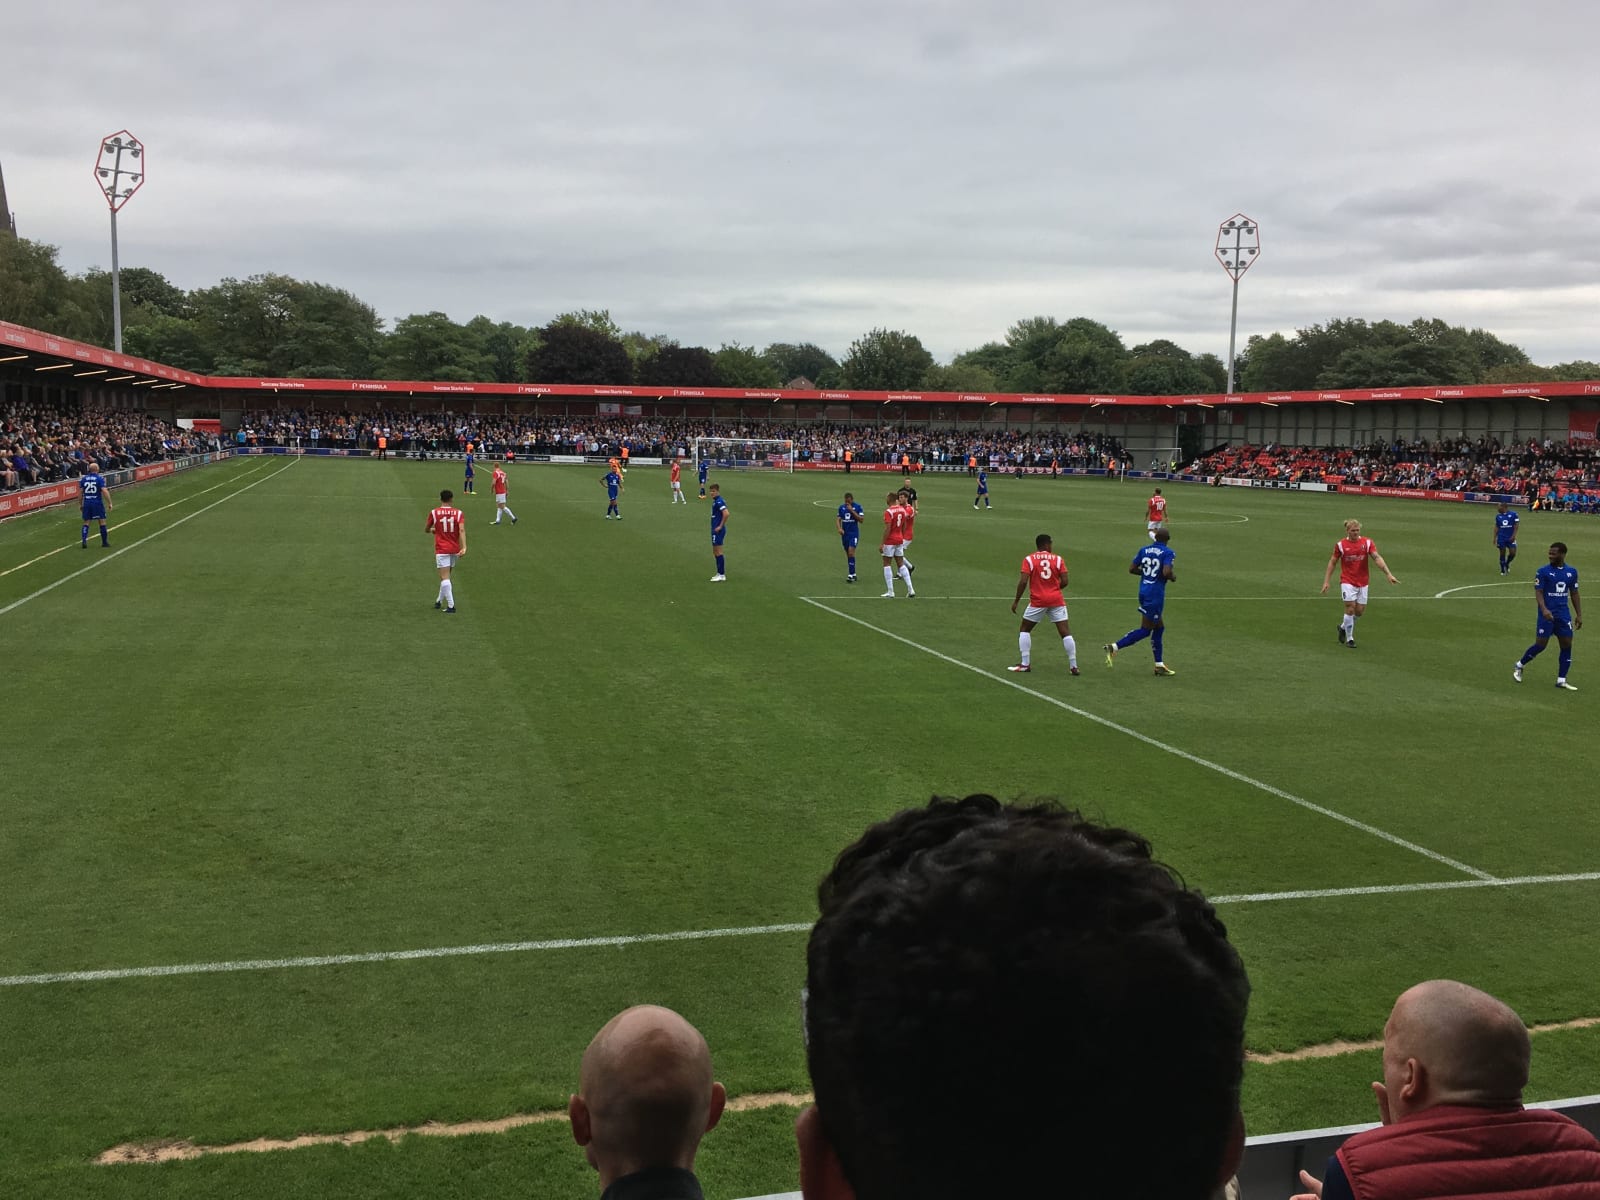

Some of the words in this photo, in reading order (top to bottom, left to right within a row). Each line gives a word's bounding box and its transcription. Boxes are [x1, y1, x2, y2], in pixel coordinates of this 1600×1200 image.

[84, 482, 97, 493] 25
[440, 516, 454, 532] 11
[1040, 560, 1052, 579] 3
[1142, 557, 1160, 577] 32
